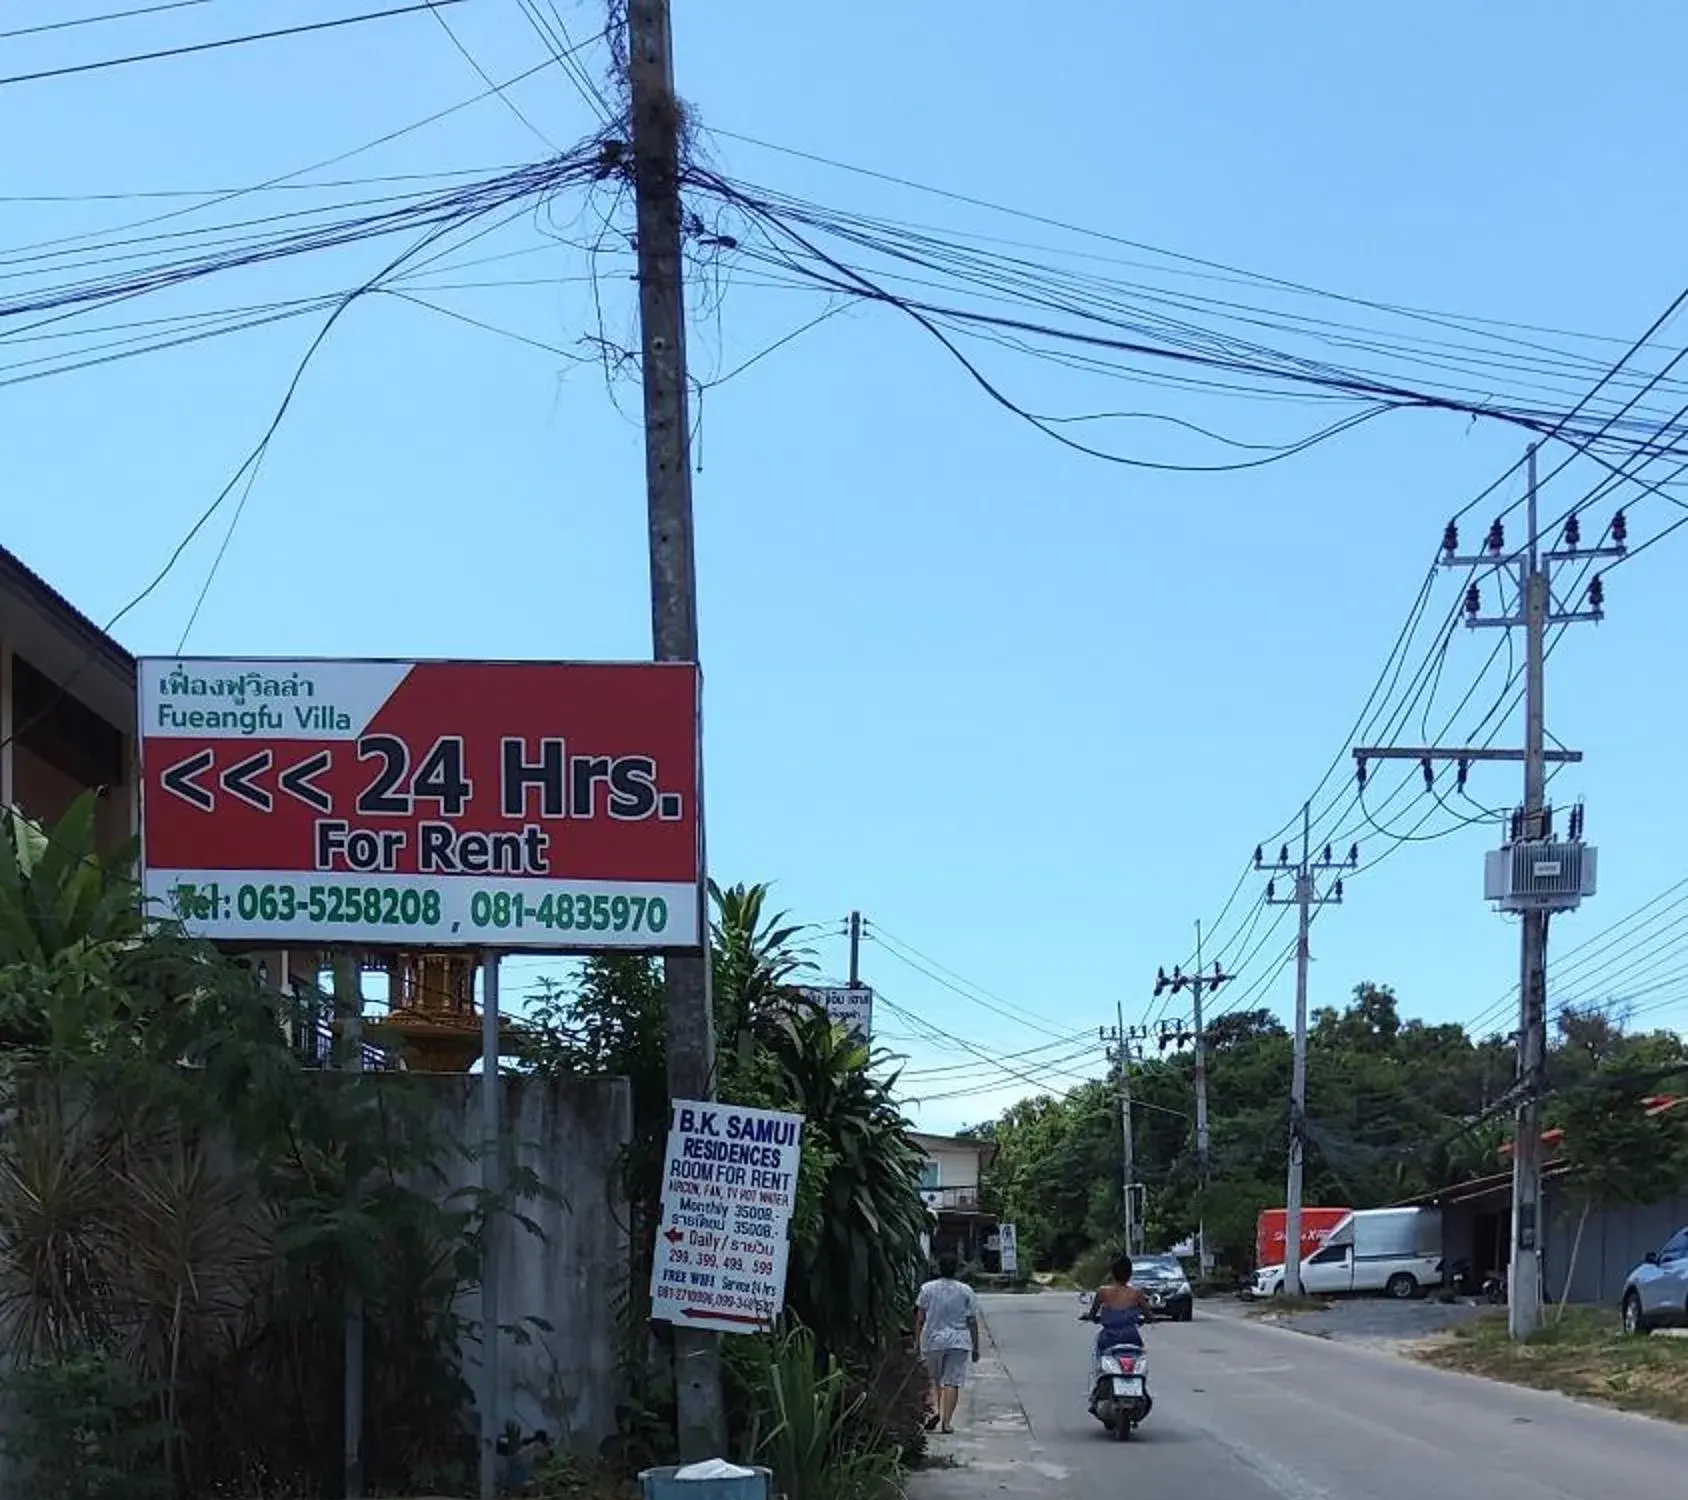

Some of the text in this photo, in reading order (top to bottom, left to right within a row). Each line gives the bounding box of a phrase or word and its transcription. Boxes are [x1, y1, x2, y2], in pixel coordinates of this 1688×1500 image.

[159, 704, 351, 734] Fueangfu Villa
[356, 734, 683, 822] 24 Hrs.
[313, 818, 550, 875] For Rent
[237, 884, 442, 928] 063-5258208
[470, 891, 668, 933] 081-4835970
[726, 1115, 797, 1146] SAMUI
[683, 1137, 781, 1168] RESIDENCES
[670, 1159, 793, 1190] ROOM FOR RENT
